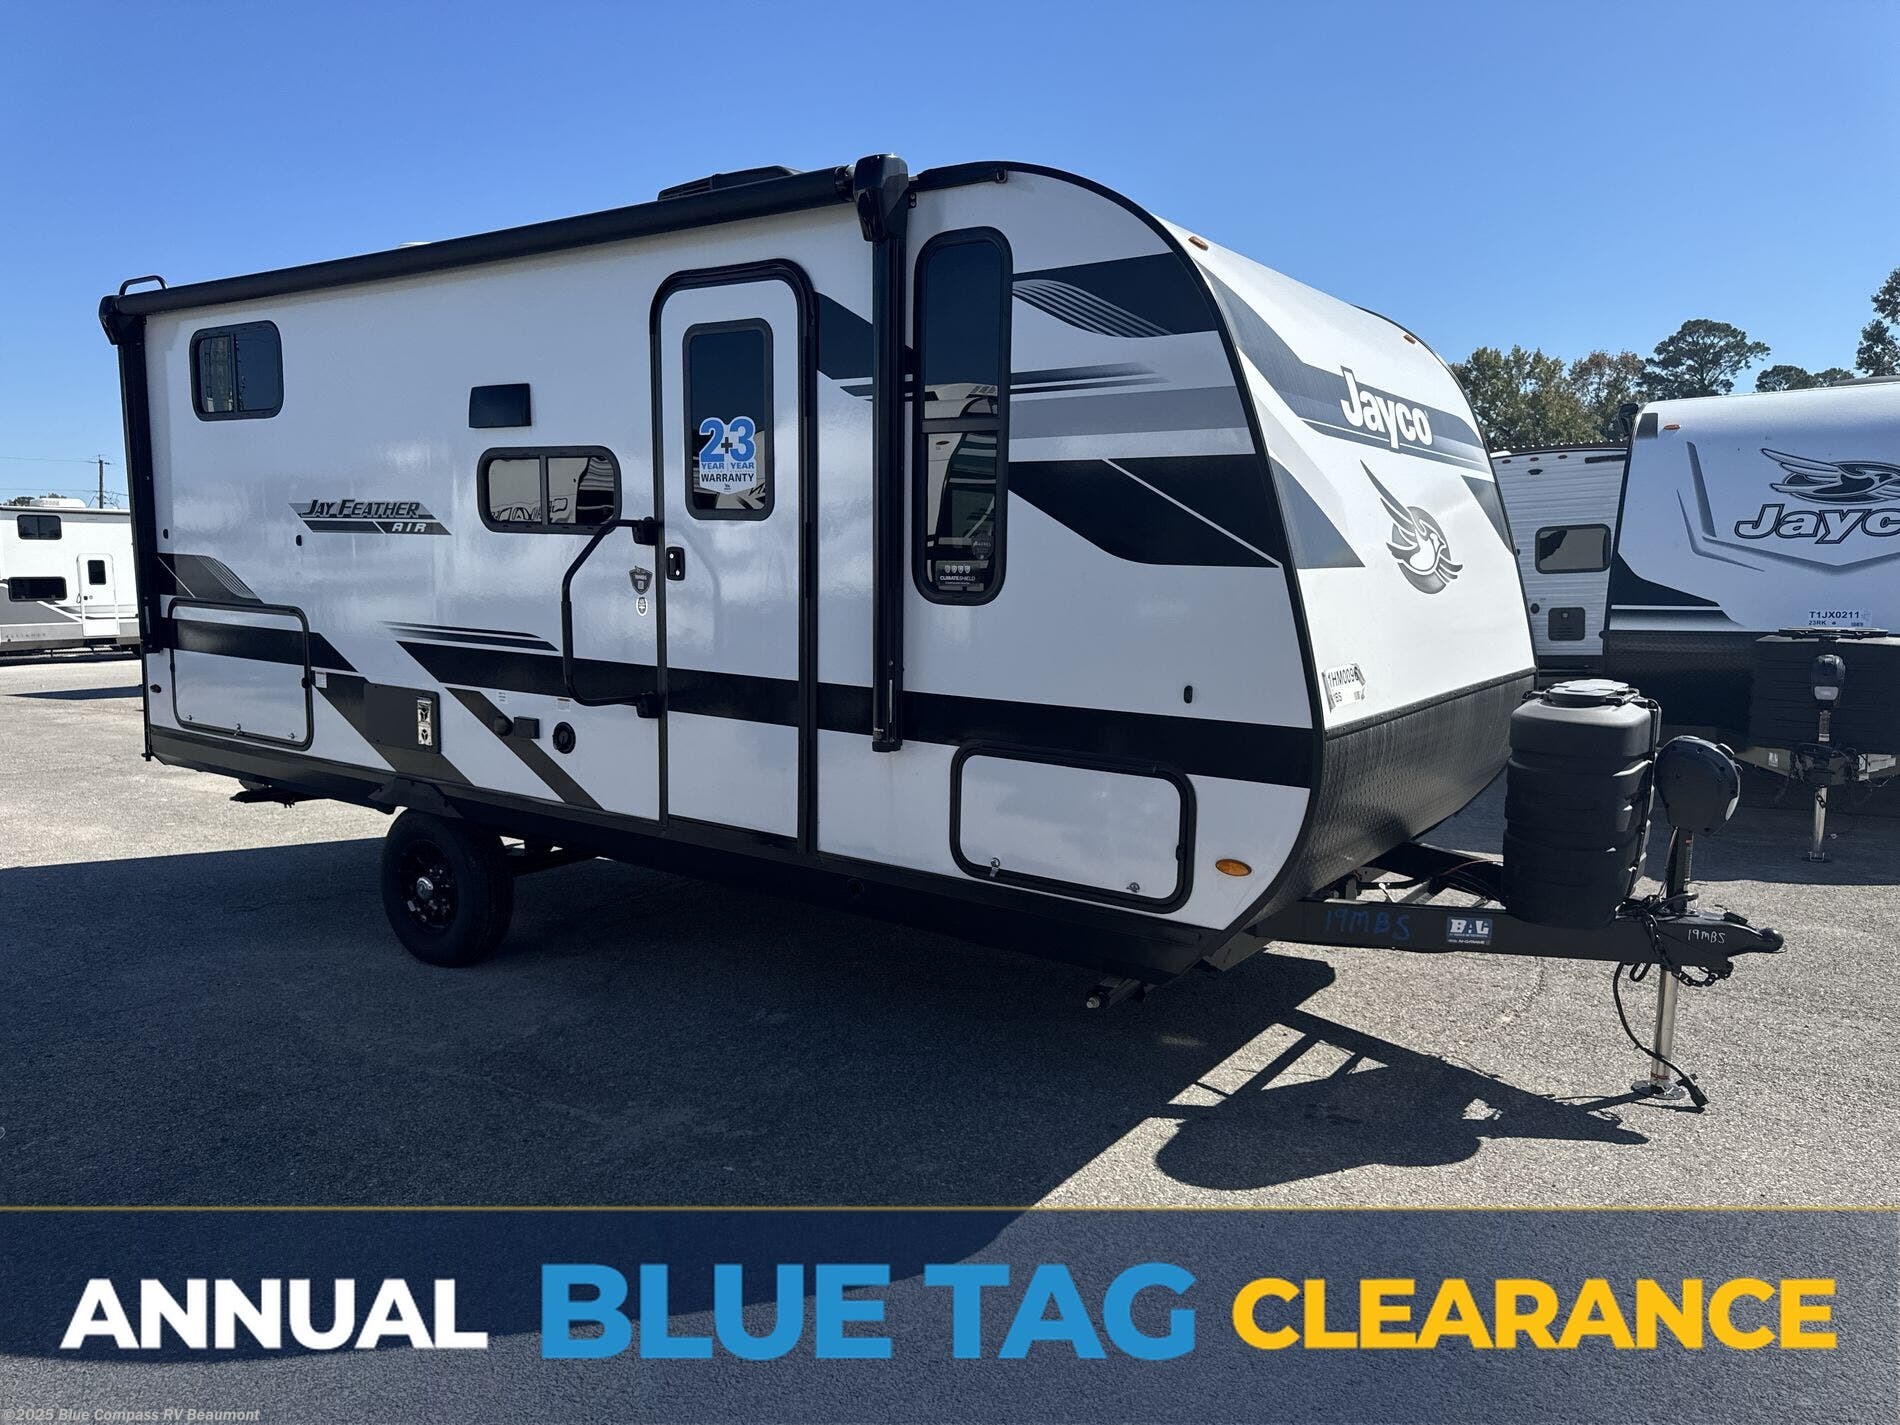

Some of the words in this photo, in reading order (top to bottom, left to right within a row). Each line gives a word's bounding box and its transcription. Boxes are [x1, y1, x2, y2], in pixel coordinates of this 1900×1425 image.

[1340, 366, 1433, 449] Jayco
[701, 462, 725, 470] YEAR
[731, 462, 754, 470] YEAR
[701, 473, 754, 483] WARRANTY
[391, 522, 427, 533] AIR
[1809, 611, 1860, 619] T1JX0211
[1450, 919, 1489, 934] BAL
